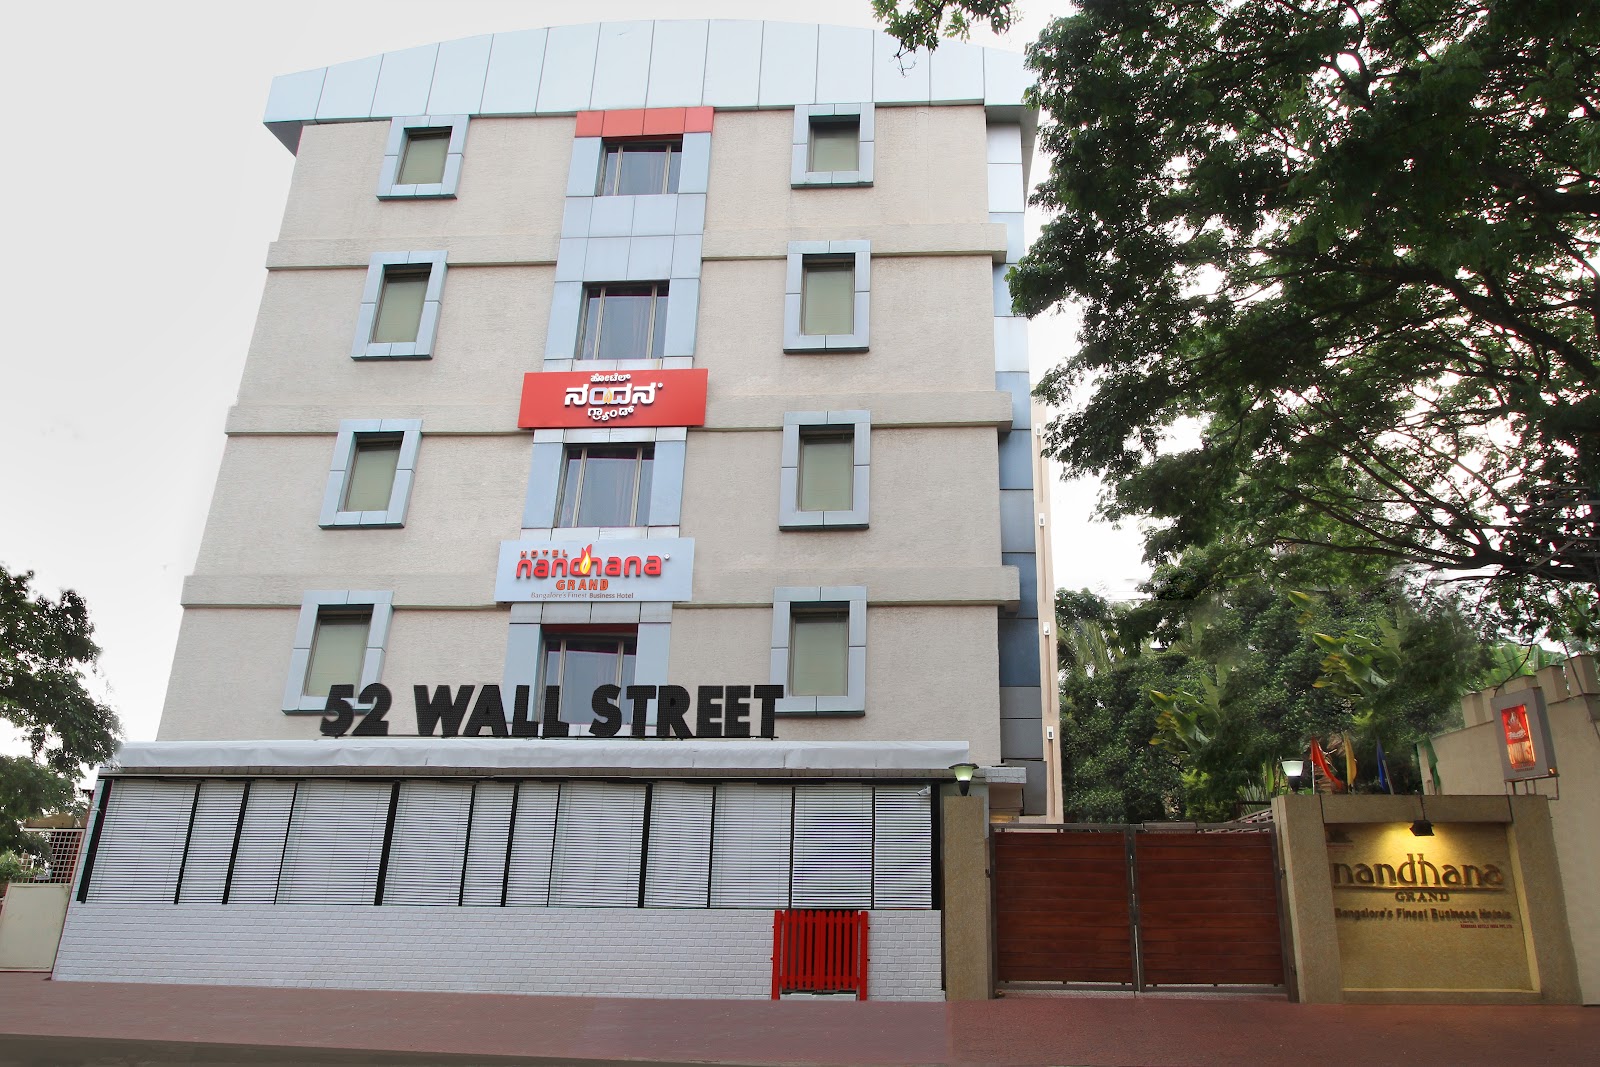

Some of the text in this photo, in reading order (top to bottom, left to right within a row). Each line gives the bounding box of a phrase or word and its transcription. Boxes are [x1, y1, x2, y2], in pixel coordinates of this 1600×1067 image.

[520, 549, 568, 558] HOTEL
[516, 544, 662, 578] nandhana
[556, 579, 609, 591] GRAND
[530, 592, 567, 600] Bangalore's
[320, 682, 784, 739] 52 WALL STREET
[1331, 853, 1505, 886] nandhana
[1395, 891, 1451, 903] GRAND
[1396, 908, 1428, 920] Finest
